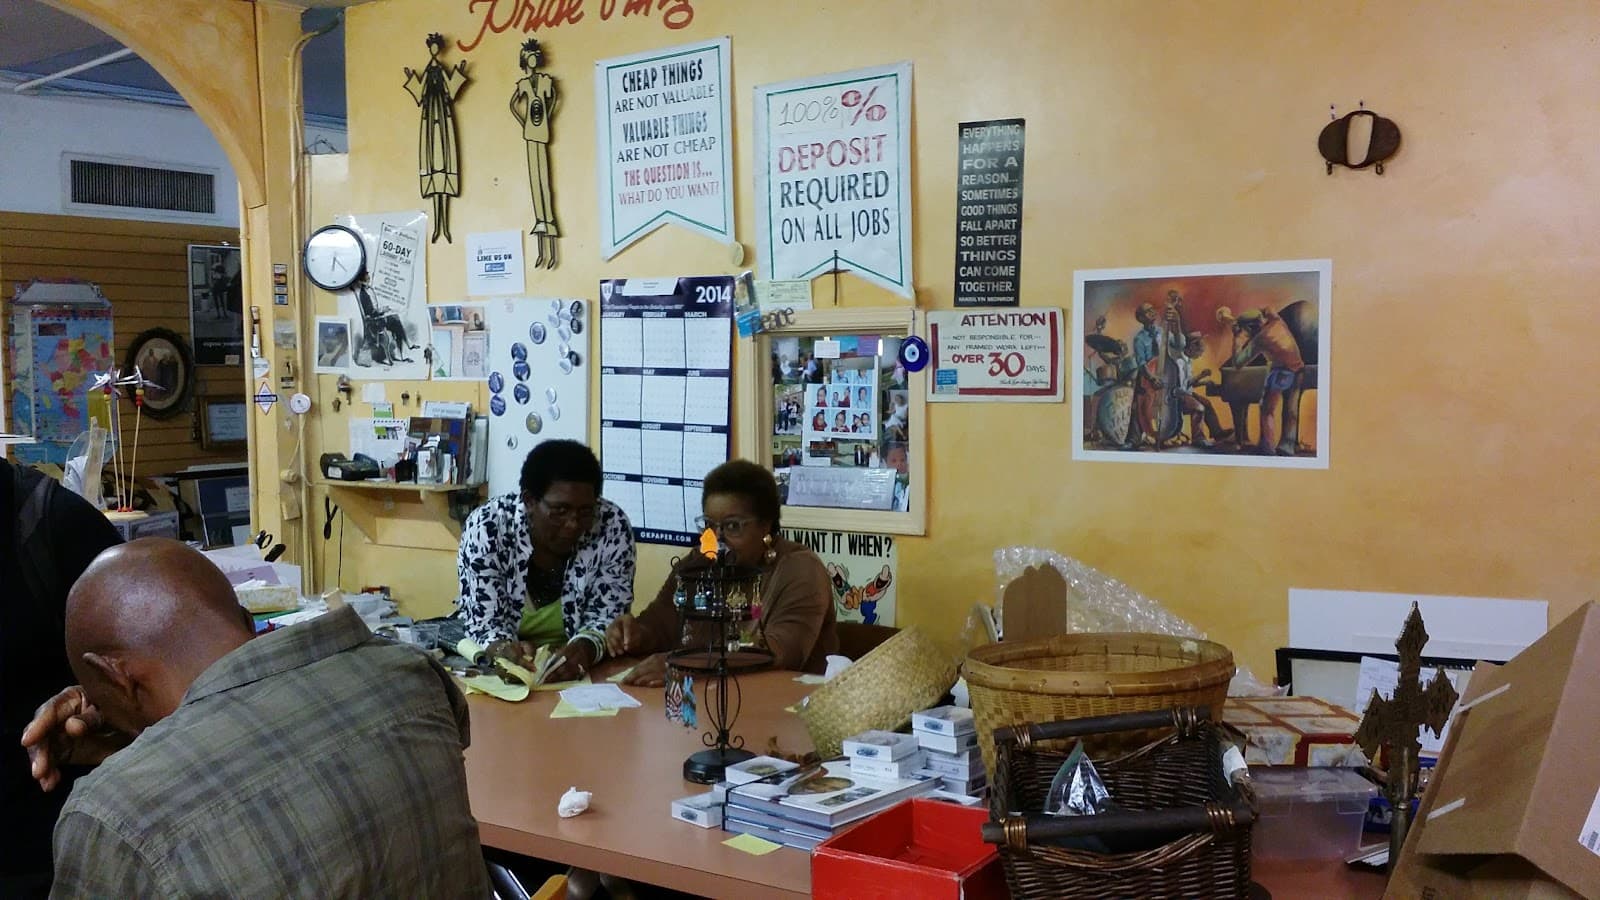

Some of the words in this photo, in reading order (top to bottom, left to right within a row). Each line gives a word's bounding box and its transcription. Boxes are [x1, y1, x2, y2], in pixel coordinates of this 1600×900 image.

[622, 66, 658, 93] CHEAP
[661, 58, 704, 87] THINGS
[614, 98, 635, 113] ARE
[636, 93, 660, 110] NOT
[662, 83, 715, 104] VALUABLE
[778, 95, 839, 127] 100%
[622, 116, 670, 144] VALUABLE
[671, 110, 708, 138] THINGS
[962, 124, 1020, 139] EVERYTHING
[616, 148, 640, 163] ARE
[643, 143, 669, 160] NOT
[673, 136, 717, 155] CHEAP
[778, 133, 888, 174] DEPOSIT
[962, 140, 1020, 155] HAPPENS
[962, 158, 999, 171] FOR
[1004, 156, 1018, 168] A
[624, 169, 641, 188] THE
[643, 162, 690, 186] QUESTION
[691, 160, 713, 180] IS...
[962, 172, 1019, 186] REASON...
[618, 190, 645, 205] WHAT
[647, 187, 663, 203] DO
[664, 184, 685, 201] YOU
[687, 180, 720, 197] WANT?
[780, 169, 890, 211] REQUIRED
[961, 187, 1018, 201] SOMETIMES
[960, 204, 985, 217] GOOD
[986, 202, 1018, 216] THINGS
[781, 216, 806, 245] ON
[814, 212, 843, 242] ALL
[851, 207, 891, 243] JOBS
[960, 219, 983, 232] FALL
[984, 218, 1018, 231] APART
[960, 235, 974, 248] SO
[976, 234, 1017, 247] BETTER
[382, 240, 413, 258] 60-DAY
[960, 249, 1017, 262] THINGS
[476, 254, 493, 262] LIKE
[959, 265, 982, 278] CAN
[984, 265, 1015, 277] COME
[959, 280, 1015, 293] TOGETHER.
[695, 285, 732, 304] 2014
[960, 312, 1046, 327] ATTENTION
[951, 353, 985, 364] OVER
[988, 351, 1026, 378] 30
[602, 473, 626, 481] OCTOBER
[640, 531, 692, 542] OKPAPER.COM
[793, 530, 828, 553] WANT
[831, 532, 843, 554] IT
